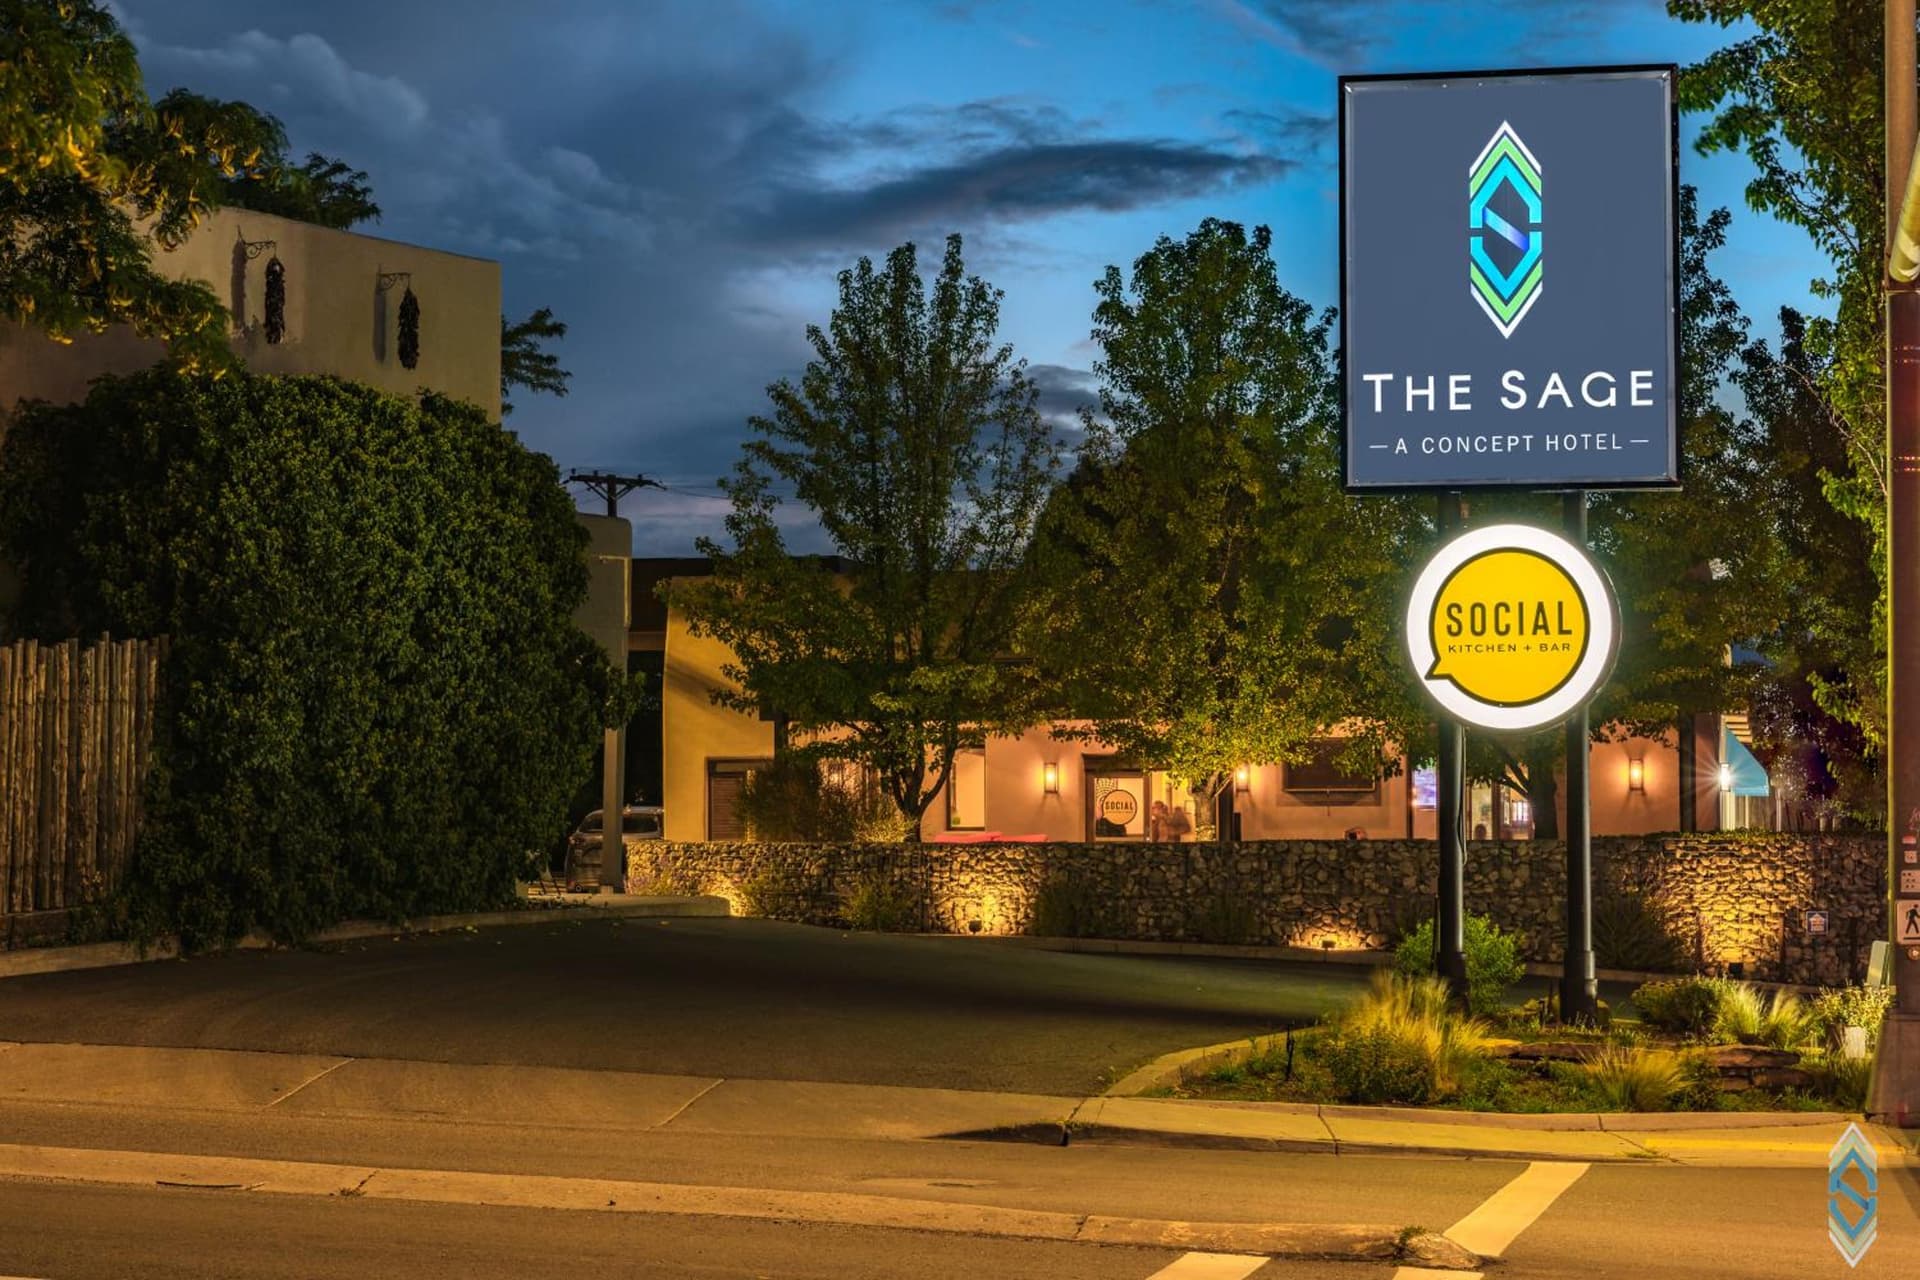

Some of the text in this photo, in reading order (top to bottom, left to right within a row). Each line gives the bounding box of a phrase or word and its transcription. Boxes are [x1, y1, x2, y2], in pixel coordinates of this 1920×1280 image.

[1362, 369, 1654, 413] THE SAGE
[1394, 432, 1623, 455] A CONCEPT HOTEL
[1446, 601, 1573, 638] SOCIAL
[1447, 643, 1517, 654] KITCHEN
[1538, 642, 1571, 653] BAR
[1105, 801, 1133, 810] SOCIAL
